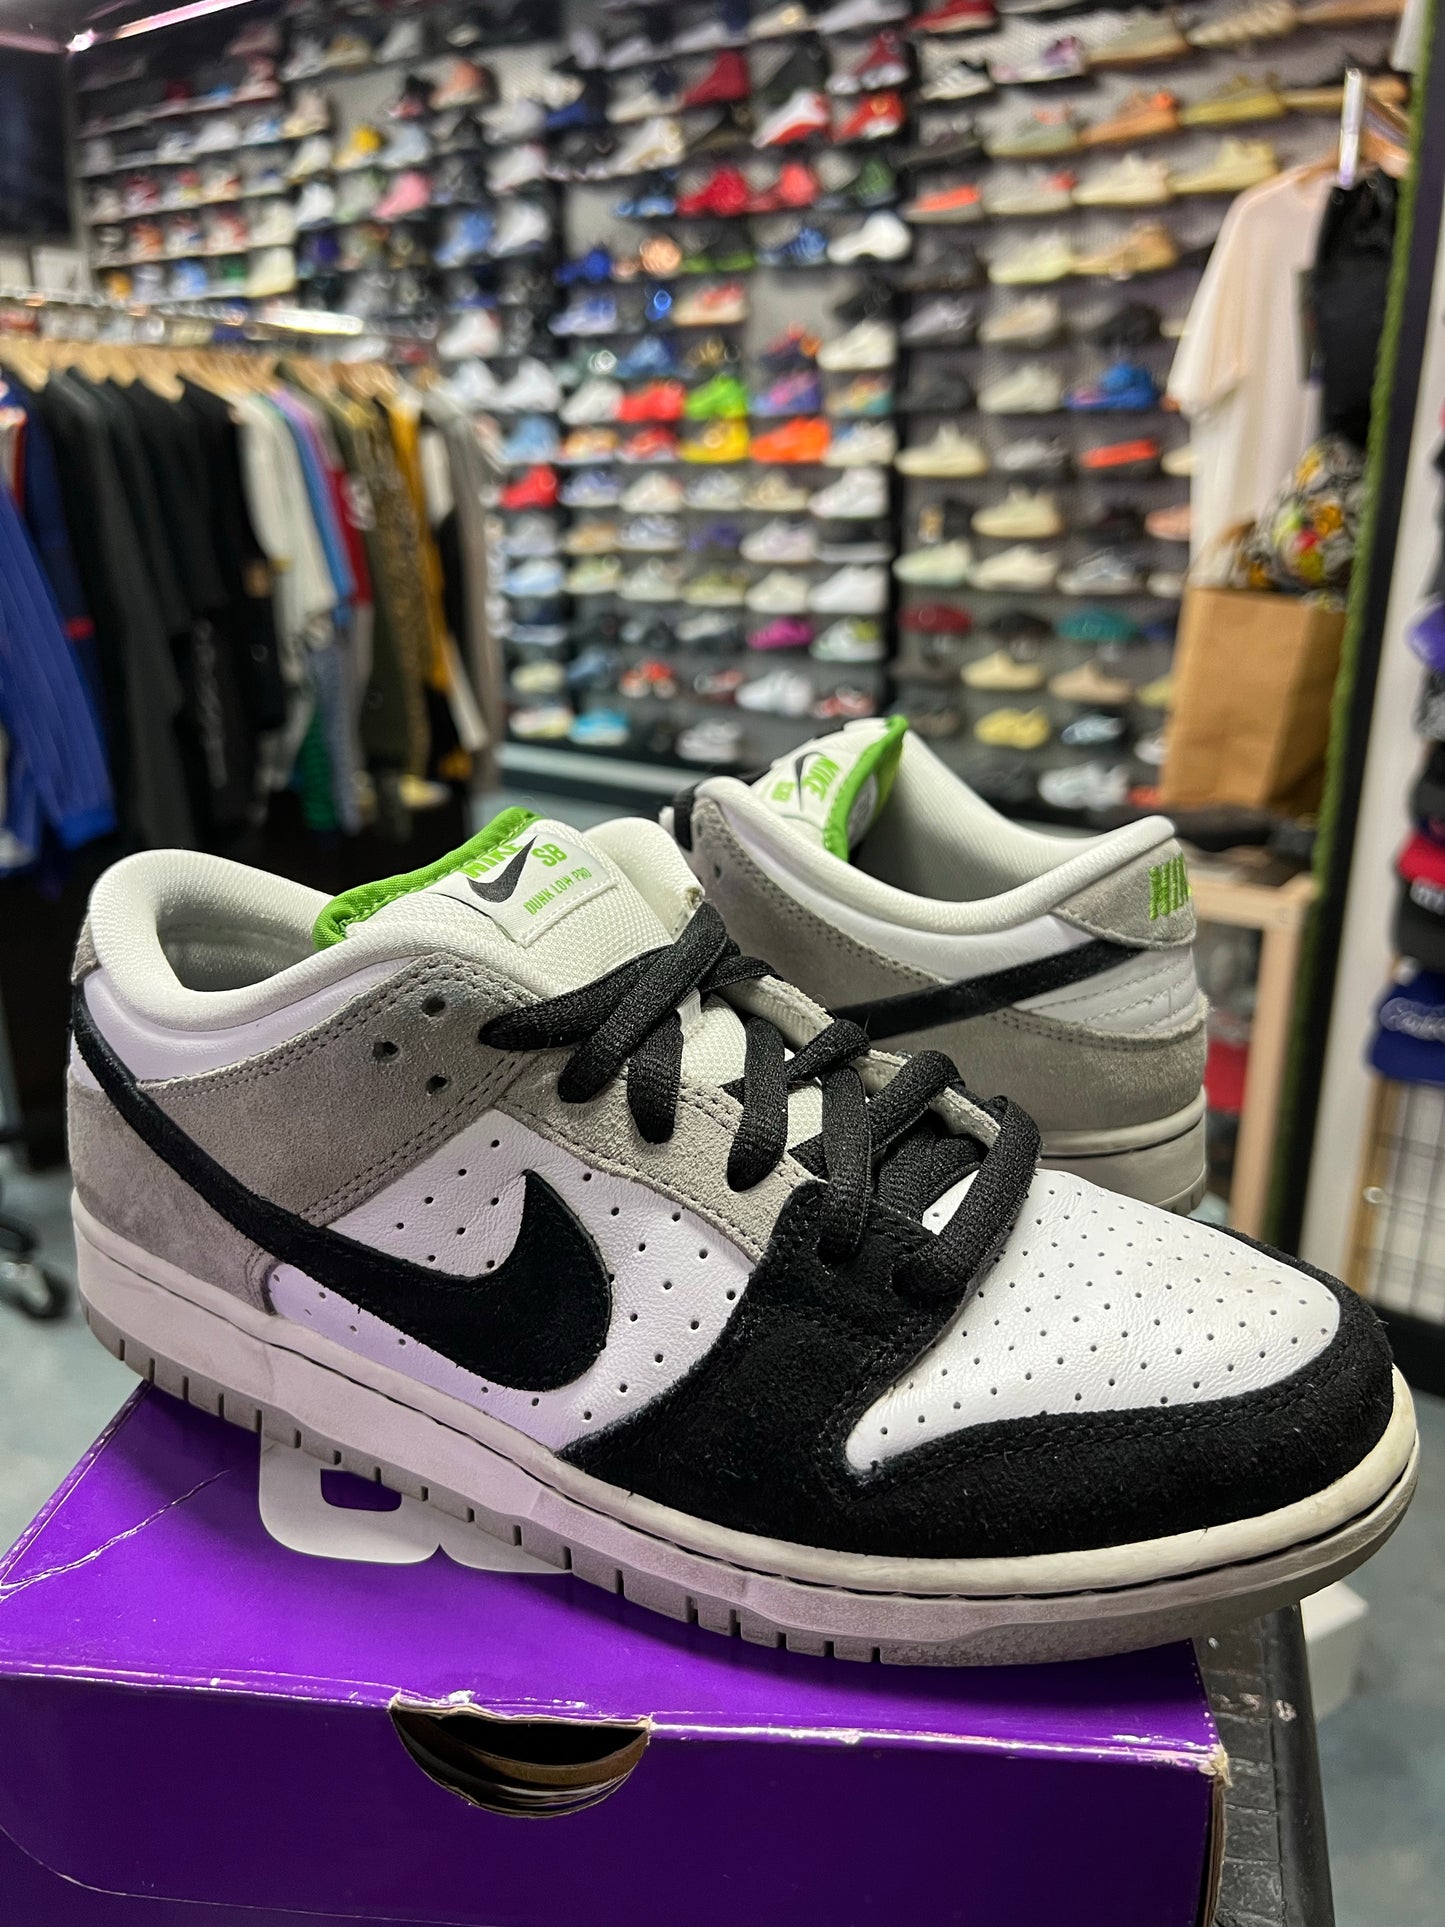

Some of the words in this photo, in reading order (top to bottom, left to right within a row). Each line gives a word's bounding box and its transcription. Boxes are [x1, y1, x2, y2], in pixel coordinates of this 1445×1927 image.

[530, 842, 568, 867] SB
[522, 887, 555, 916] DUNK
[551, 874, 575, 897] LOW
[571, 866, 592, 883] PRO
